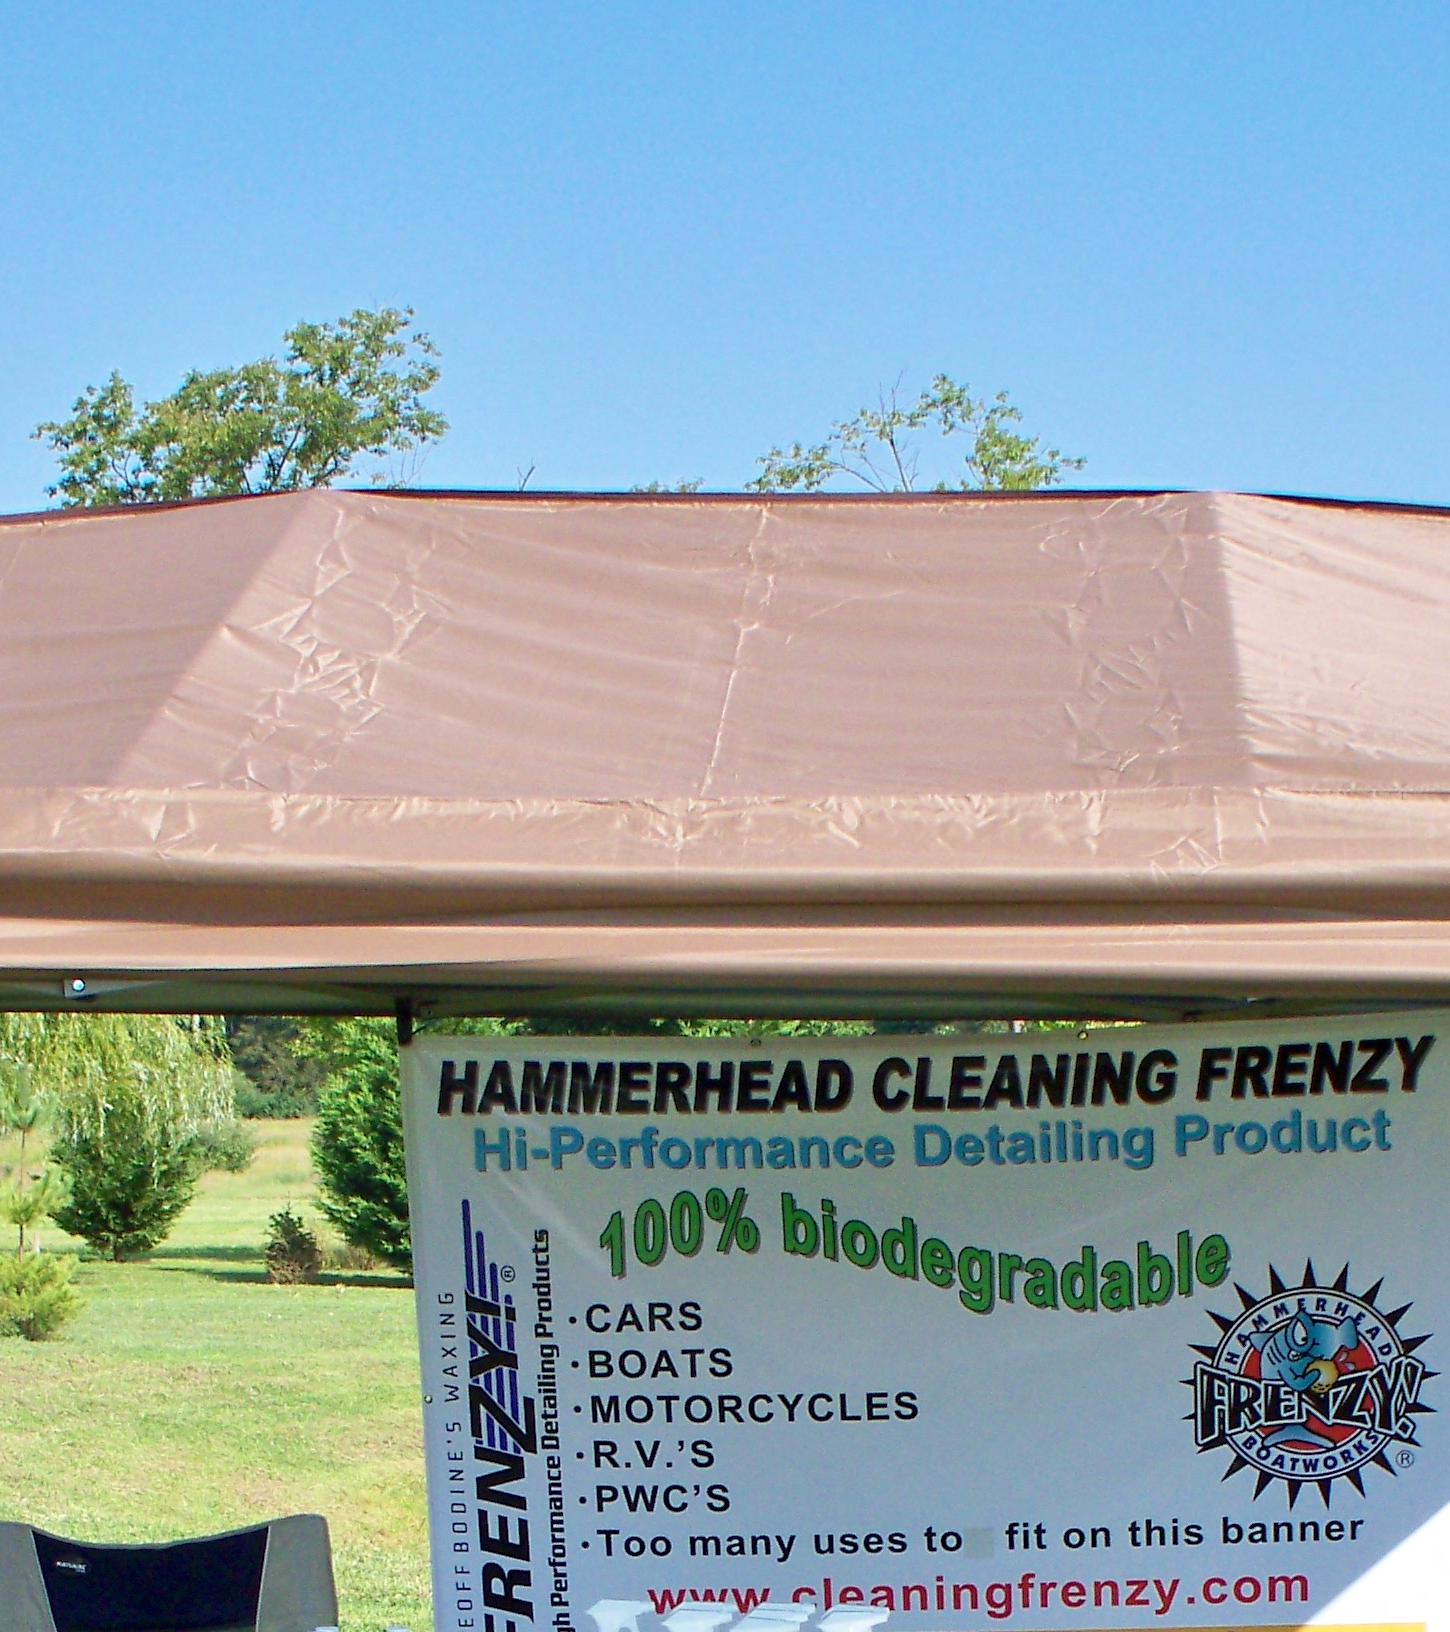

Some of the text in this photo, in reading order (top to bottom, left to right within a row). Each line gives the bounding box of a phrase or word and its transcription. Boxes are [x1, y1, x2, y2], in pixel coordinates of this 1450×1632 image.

[437, 1034, 1438, 1117] HAMMERHEAD CLEANING FRENZY
[473, 1107, 1392, 1173] Hi-Performance Detailing Product
[532, 1229, 554, 1338] Products
[599, 1187, 1233, 1315] 100% biodegradable
[437, 1292, 460, 1403] WAXING
[584, 1301, 704, 1333] CARS
[1224, 1297, 1392, 1366] HAMMERHEAD
[537, 1343, 560, 1451] Detailing
[588, 1348, 734, 1379] BOATS
[590, 1391, 920, 1424] MOTORCYCLES
[1194, 1355, 1426, 1445] FRENZY!
[446, 1421, 470, 1553] BODINE'S
[1241, 1431, 1380, 1474] BOATWORKS
[547, 1455, 570, 1607] Performance
[595, 1484, 731, 1513] PWC'S
[596, 1516, 1365, 1563] Too many uses to fit on this banner
[647, 1573, 1309, 1619] wwwcleaningfrenzy.com
